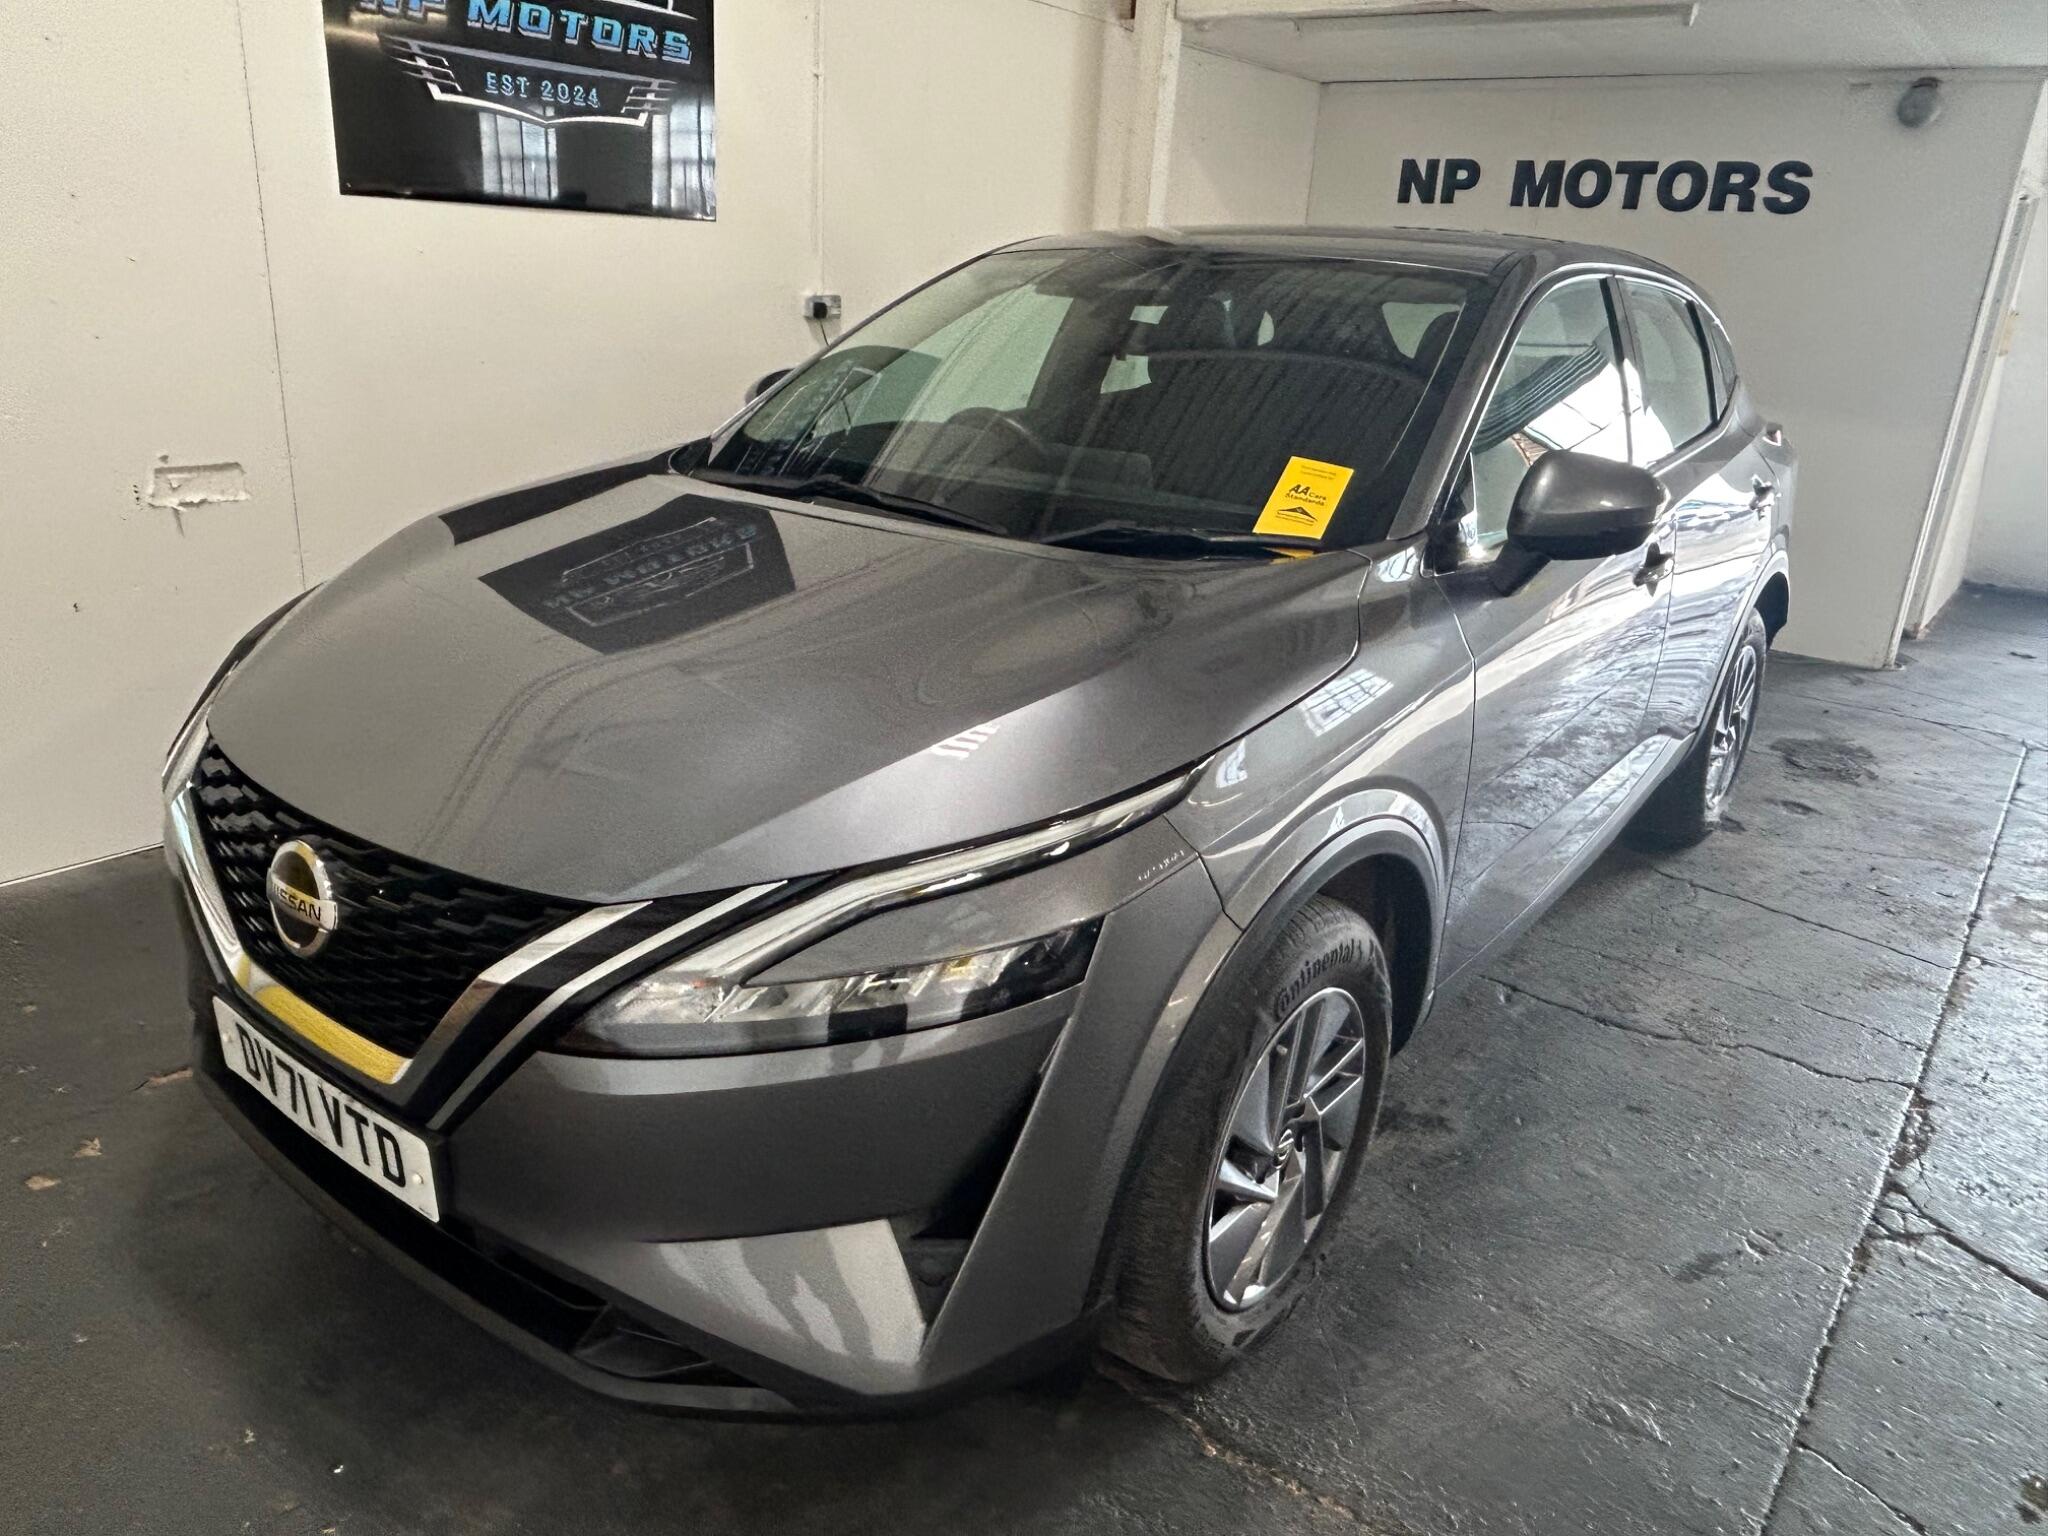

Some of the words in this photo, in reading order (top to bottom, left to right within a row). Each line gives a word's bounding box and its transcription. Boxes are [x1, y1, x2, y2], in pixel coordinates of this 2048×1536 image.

[467, 0, 692, 64] MOTORS
[485, 71, 529, 98] EST
[541, 80, 600, 108] 2024
[1397, 158, 1481, 204] NP
[1510, 158, 1813, 214] MOTORS
[1288, 484, 1311, 496] AA
